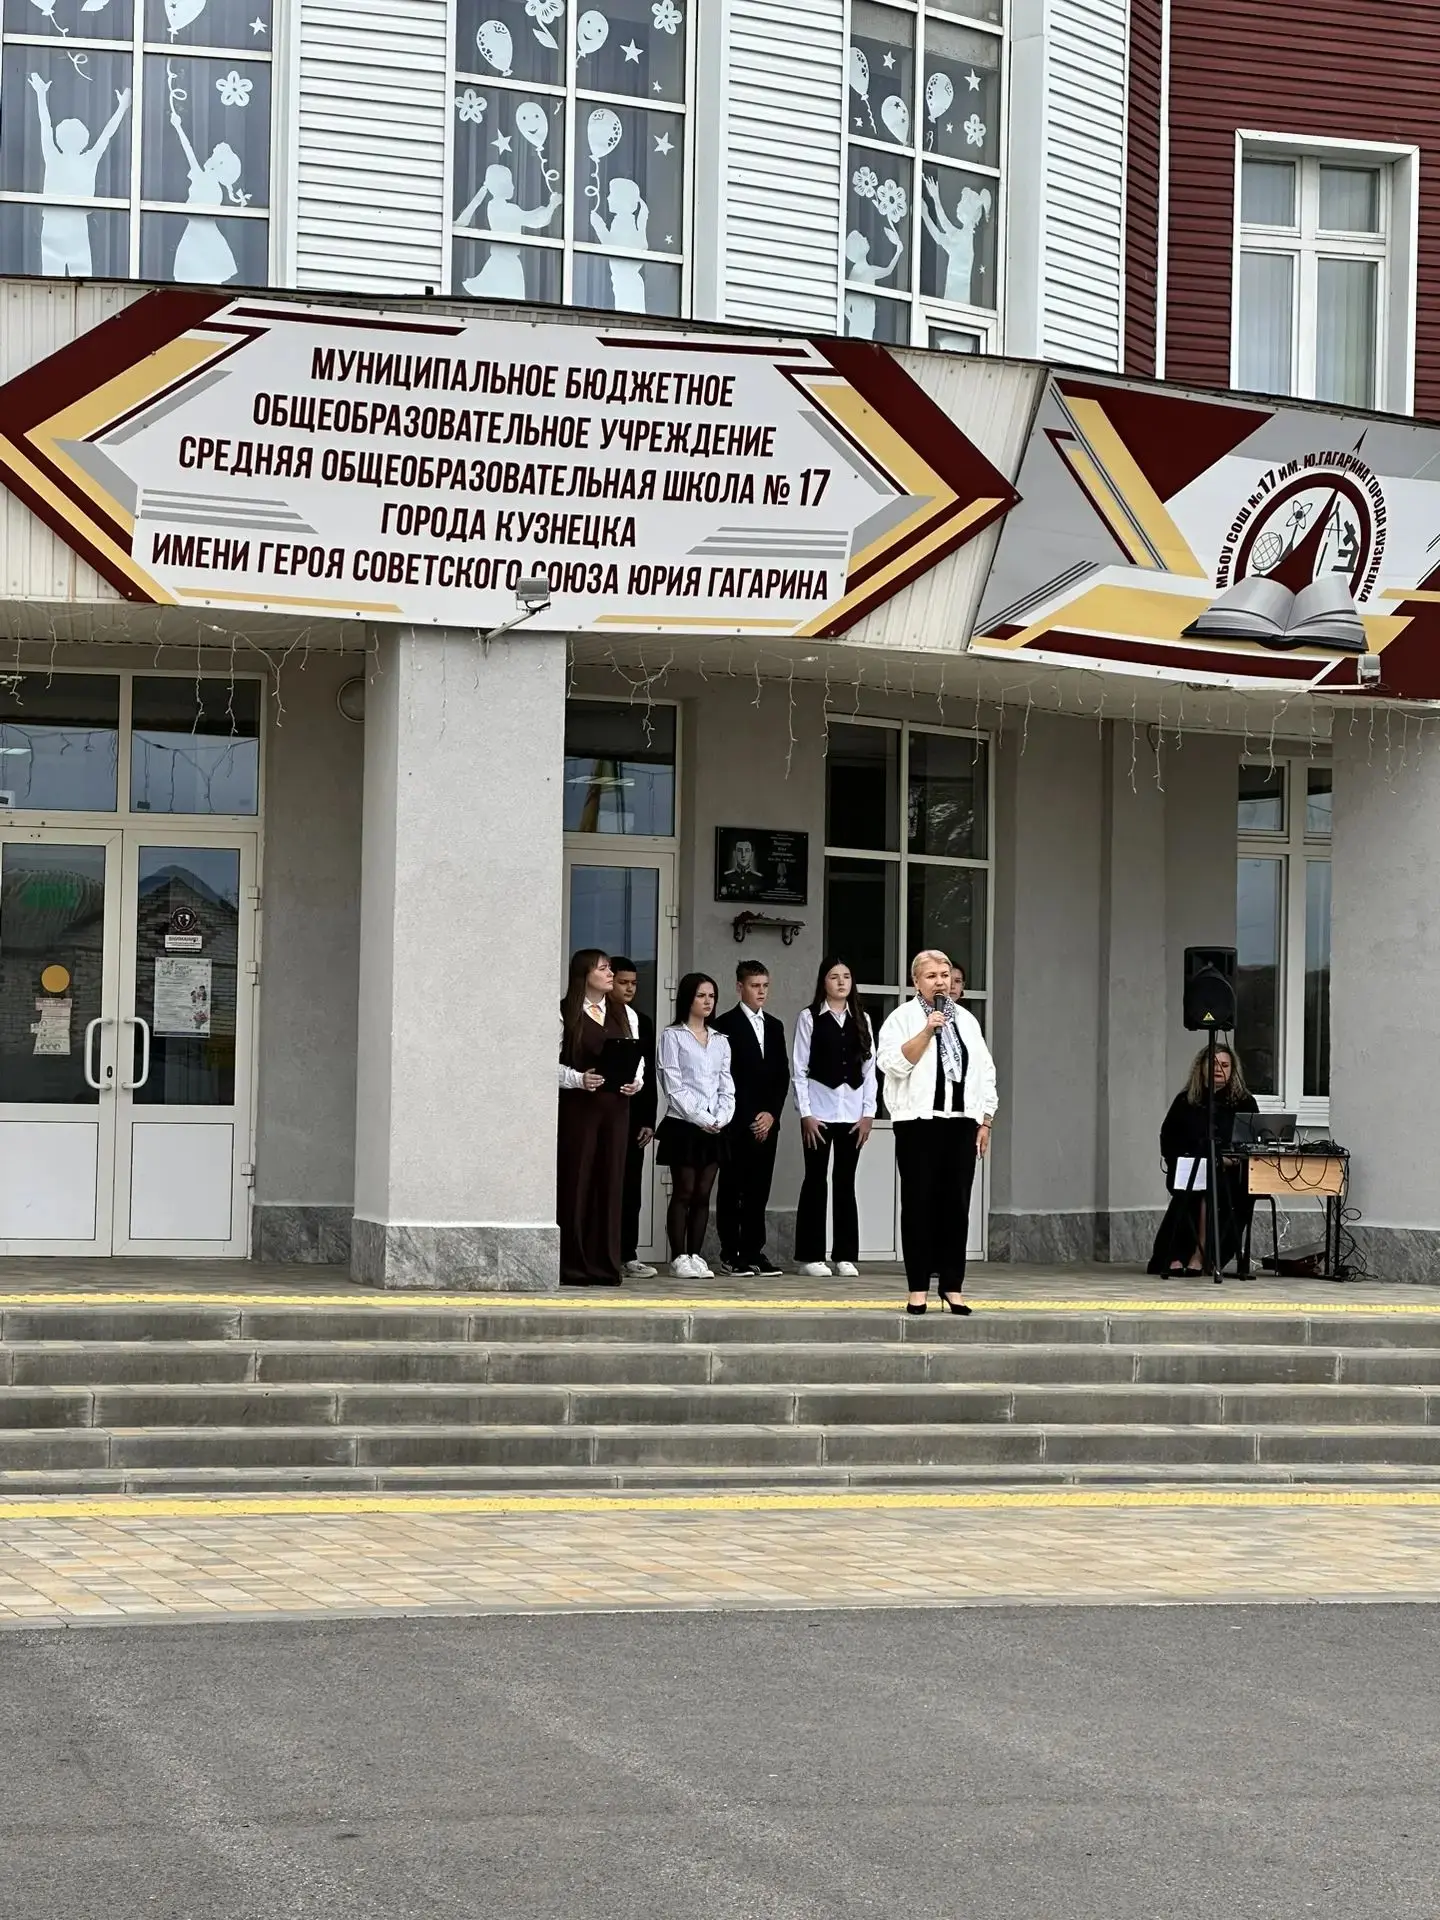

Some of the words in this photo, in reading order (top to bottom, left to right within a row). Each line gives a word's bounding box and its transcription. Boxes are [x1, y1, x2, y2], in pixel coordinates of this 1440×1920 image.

[311, 347, 558, 398] МУНИЦИПАЛЬНОЕ
[565, 366, 735, 408] БЮДЖЕТНОЕ
[253, 392, 591, 449] ОБЩЕОБРАЗОВАТЕЛЬНОЕ
[600, 418, 776, 458] УЧРЕЖДЕНИЕ
[178, 435, 313, 479] СРЕДНЯЯ
[321, 448, 656, 501] ОБЩЕОБРАЗОВАТЕЛЬНАЯ
[662, 470, 754, 505] ШКОЛА
[762, 474, 791, 505] №
[799, 468, 831, 507] 17
[1365, 474, 1387, 529] ГОРОДА
[380, 502, 485, 543] ГОРОДА
[495, 510, 636, 550] КУЗНЕЦКА
[1226, 506, 1252, 544] СОШ
[151, 532, 250, 572] ИМЕНИ
[257, 541, 345, 580] ГЕРОЯ
[352, 549, 523, 591] СОВЕТСКОГО
[627, 564, 702, 597] ЮРИЯ
[707, 567, 828, 601] ГАГАРИНА
[1215, 545, 1234, 589] МБОУ
[1357, 527, 1387, 603] КУЗНЕЦКА
